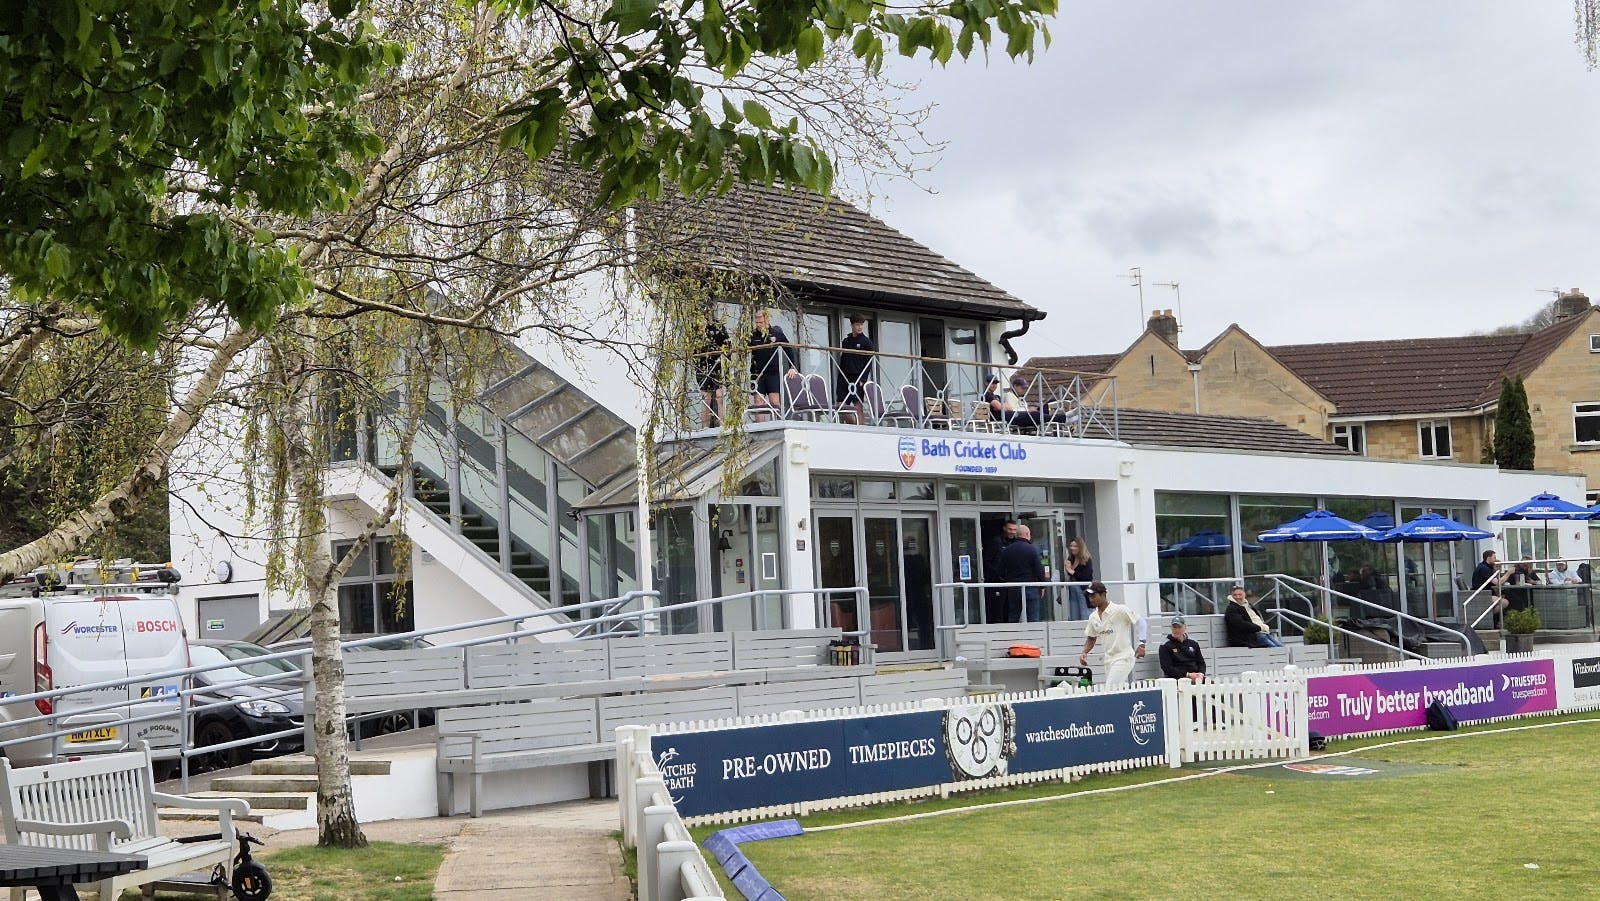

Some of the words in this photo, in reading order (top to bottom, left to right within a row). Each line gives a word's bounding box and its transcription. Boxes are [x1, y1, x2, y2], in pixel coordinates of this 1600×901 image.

[921, 438, 951, 457] Bath
[954, 440, 997, 459] Cricket
[1000, 442, 1027, 461] Club
[955, 464, 983, 473] FOUNDED
[74, 625, 118, 634] WORCESTER
[136, 620, 177, 633] BOSCH
[1510, 673, 1547, 688] TRUESPEED
[1511, 687, 1548, 700] truespeed.com
[1308, 695, 1329, 709] PEED
[1336, 690, 1373, 721] Truly
[1376, 689, 1421, 715] better
[1128, 713, 1157, 725] WATCHES
[94, 727, 111, 738] XLY
[1025, 721, 1115, 743] watchesofbath.com
[1140, 723, 1156, 734] BATH
[722, 748, 831, 780] PRE-OWNED
[849, 737, 936, 764] TIMEPIECES
[662, 762, 697, 778] ATCHES
[670, 776, 694, 790] BATH
